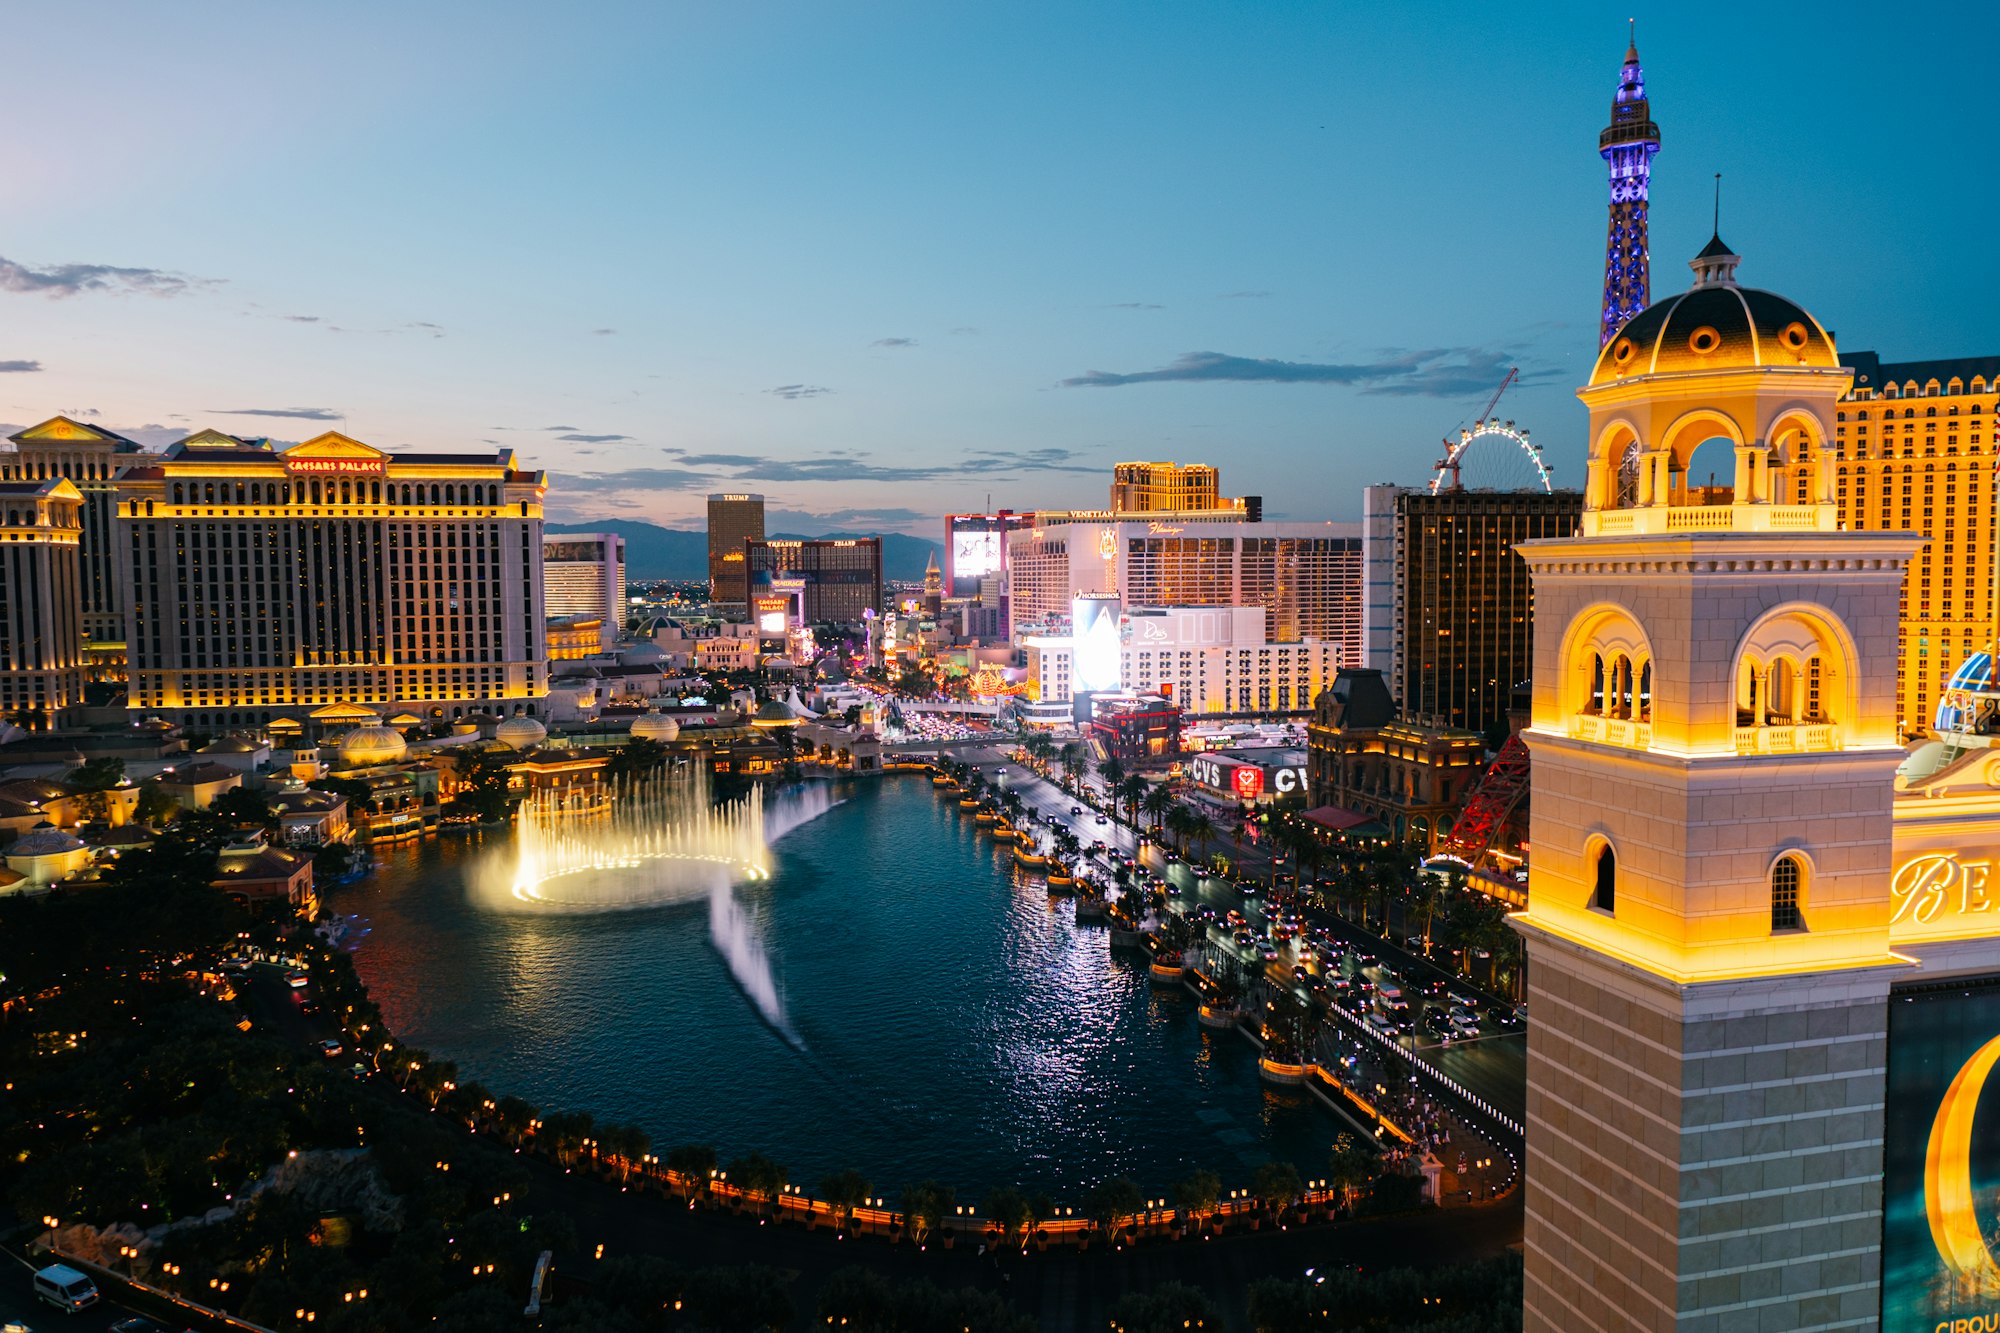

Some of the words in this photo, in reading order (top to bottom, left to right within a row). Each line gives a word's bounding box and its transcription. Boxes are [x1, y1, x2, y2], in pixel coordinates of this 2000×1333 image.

[288, 461, 336, 471] CAESARS
[339, 462, 381, 471] PALACE
[1070, 510, 1114, 518] VENETIAN
[1148, 521, 1184, 536] Flamingo
[1082, 592, 1121, 600] HORSESHOE
[1192, 757, 1220, 787] CVS
[1889, 853, 2000, 925] BE
